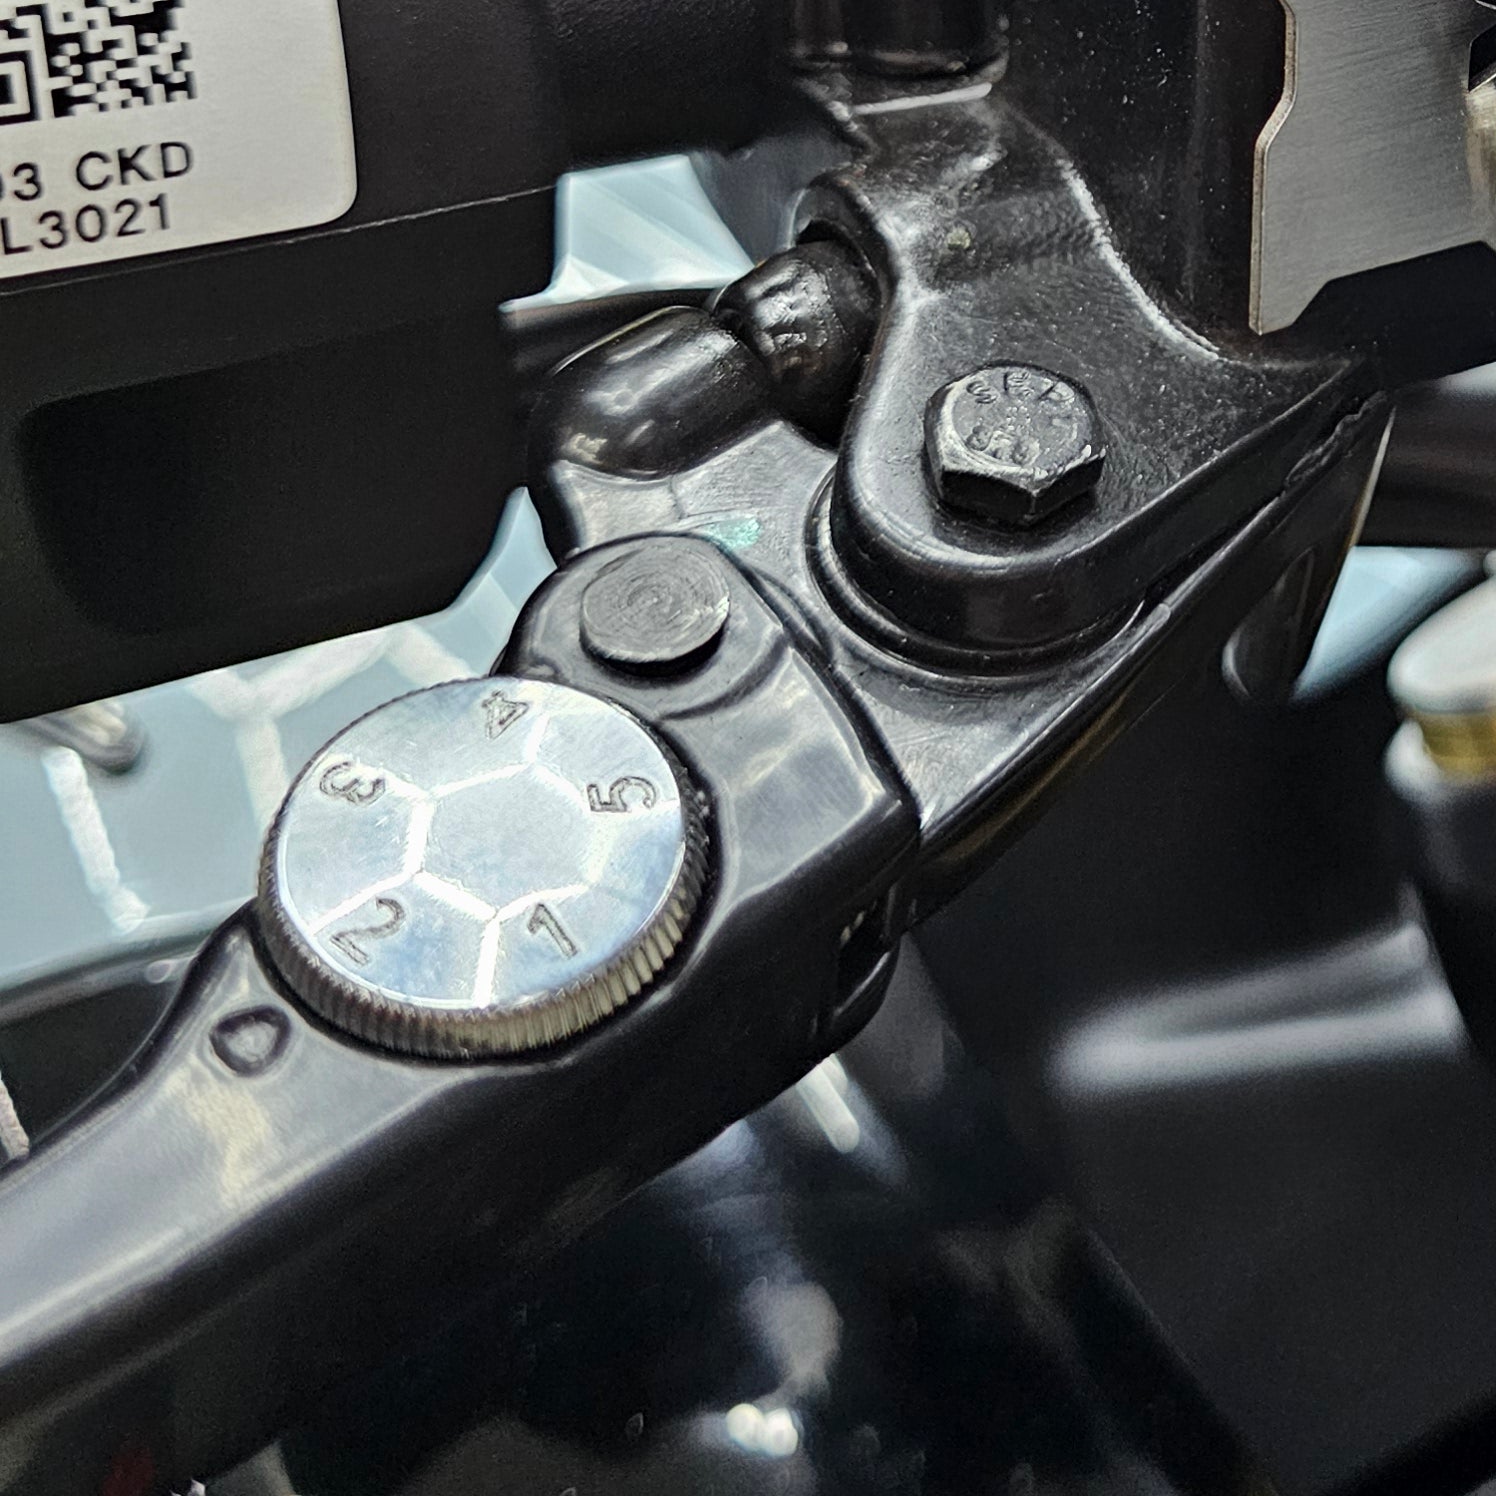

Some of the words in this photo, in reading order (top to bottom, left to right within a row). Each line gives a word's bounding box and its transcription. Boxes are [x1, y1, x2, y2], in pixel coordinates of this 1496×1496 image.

[0, 162, 43, 201] 3
[76, 141, 195, 191] CKD
[0, 193, 170, 254] L3021
[481, 689, 530, 740] 4
[319, 760, 386, 806] 3
[586, 775, 658, 814] 5
[330, 896, 406, 967] 2
[526, 902, 581, 959] 1
